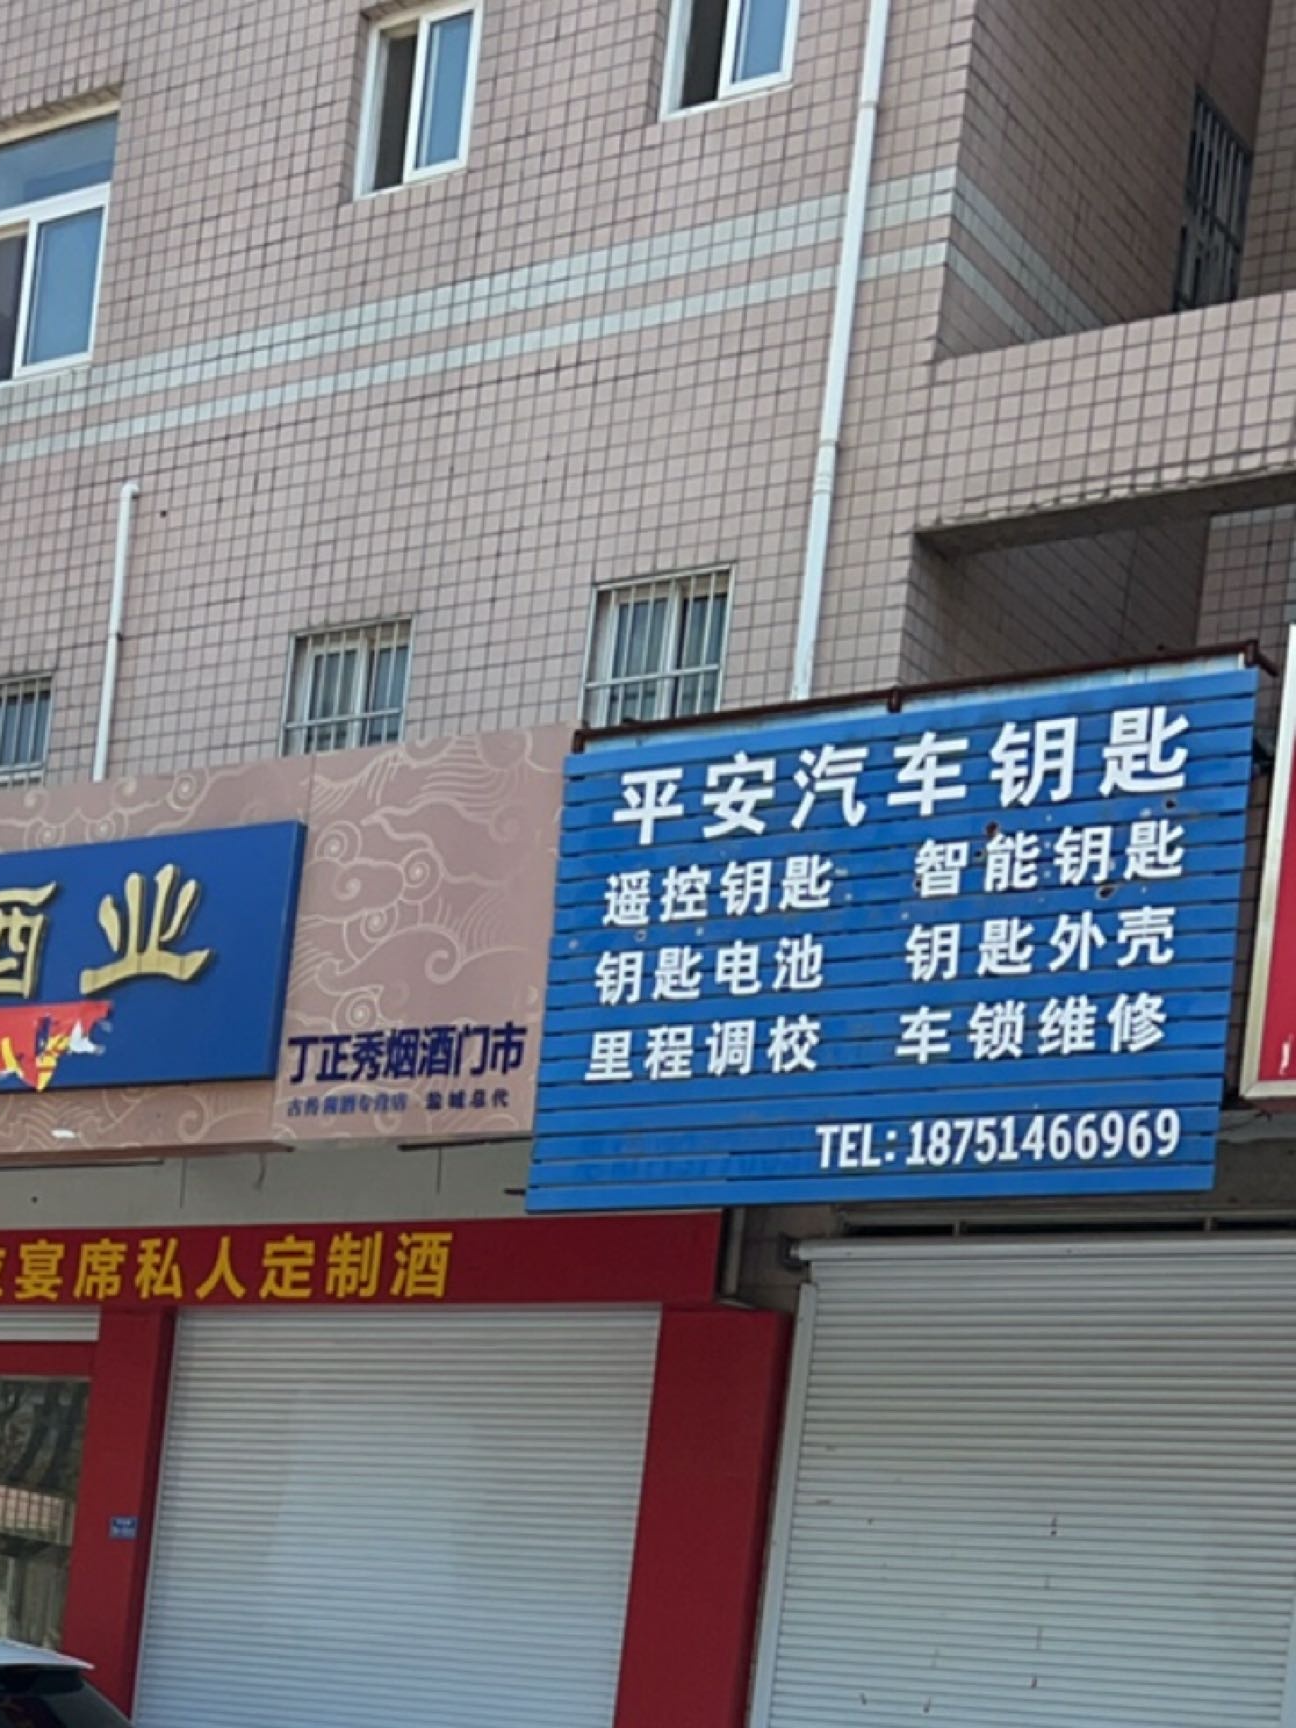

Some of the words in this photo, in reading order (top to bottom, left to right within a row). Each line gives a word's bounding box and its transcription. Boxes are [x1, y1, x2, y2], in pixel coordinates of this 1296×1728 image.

[612, 705, 1189, 845] 平安汽车钥匙
[602, 854, 835, 928] 遥控钥匙
[913, 818, 1187, 899] 智能钥匙
[594, 934, 825, 1007] 钥匙电池
[904, 905, 1176, 984] 钥匙外壳
[287, 1021, 528, 1084] 丁正秀烟酒门市
[584, 1013, 822, 1084] 里程调校
[894, 993, 1167, 1066] 车锁维修
[815, 1108, 1181, 1169] TEL:18751466969
